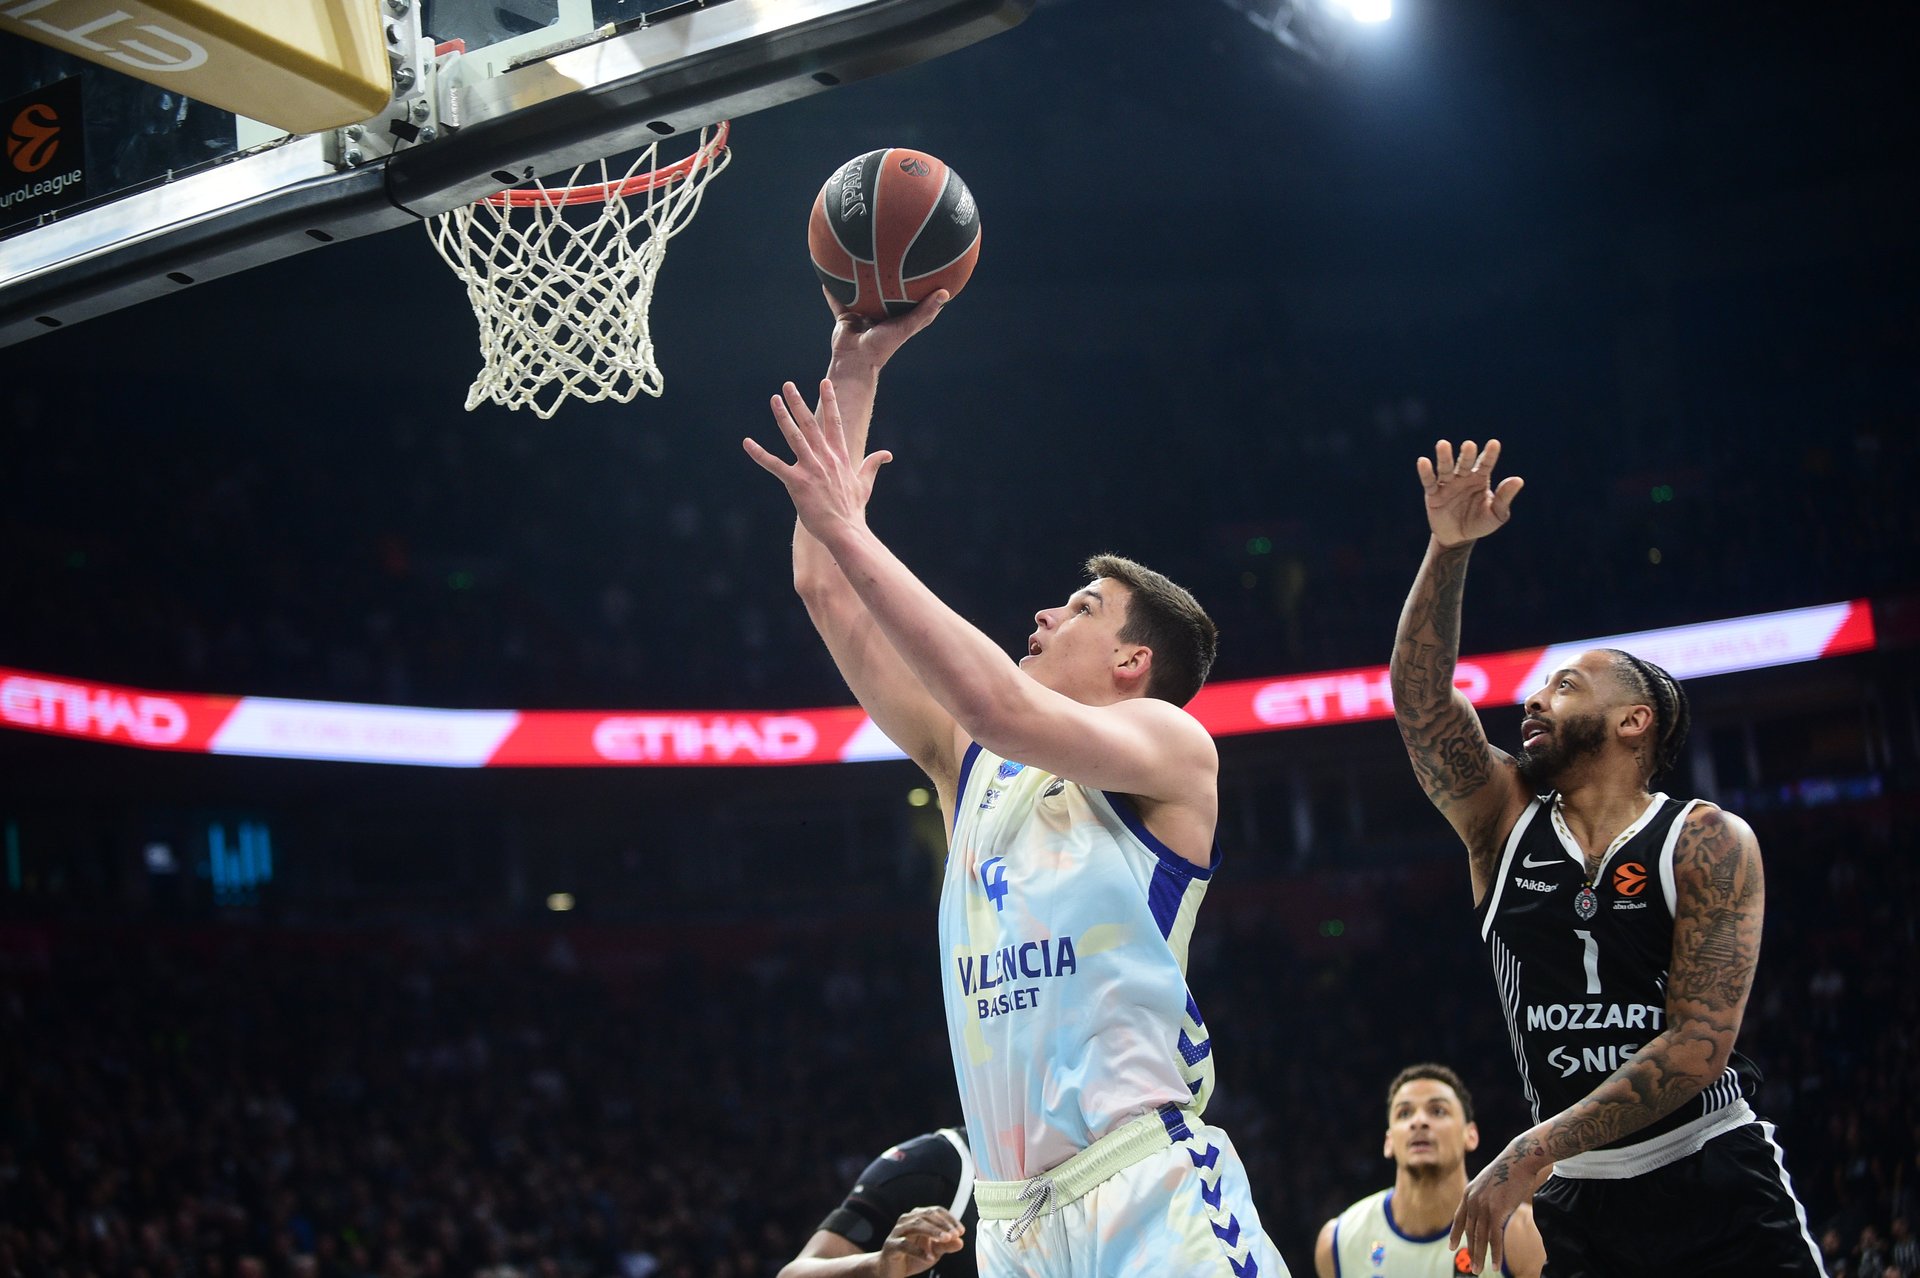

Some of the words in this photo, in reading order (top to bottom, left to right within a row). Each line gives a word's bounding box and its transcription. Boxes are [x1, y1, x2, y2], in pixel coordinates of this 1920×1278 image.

[0, 169, 82, 208] uroLeague
[1, 676, 189, 744] ETIHAD
[1253, 662, 1490, 725] ETIHD
[592, 716, 818, 761] ETIHAD
[1573, 929, 1602, 994] 1
[1527, 1003, 1666, 1032] MOZZART
